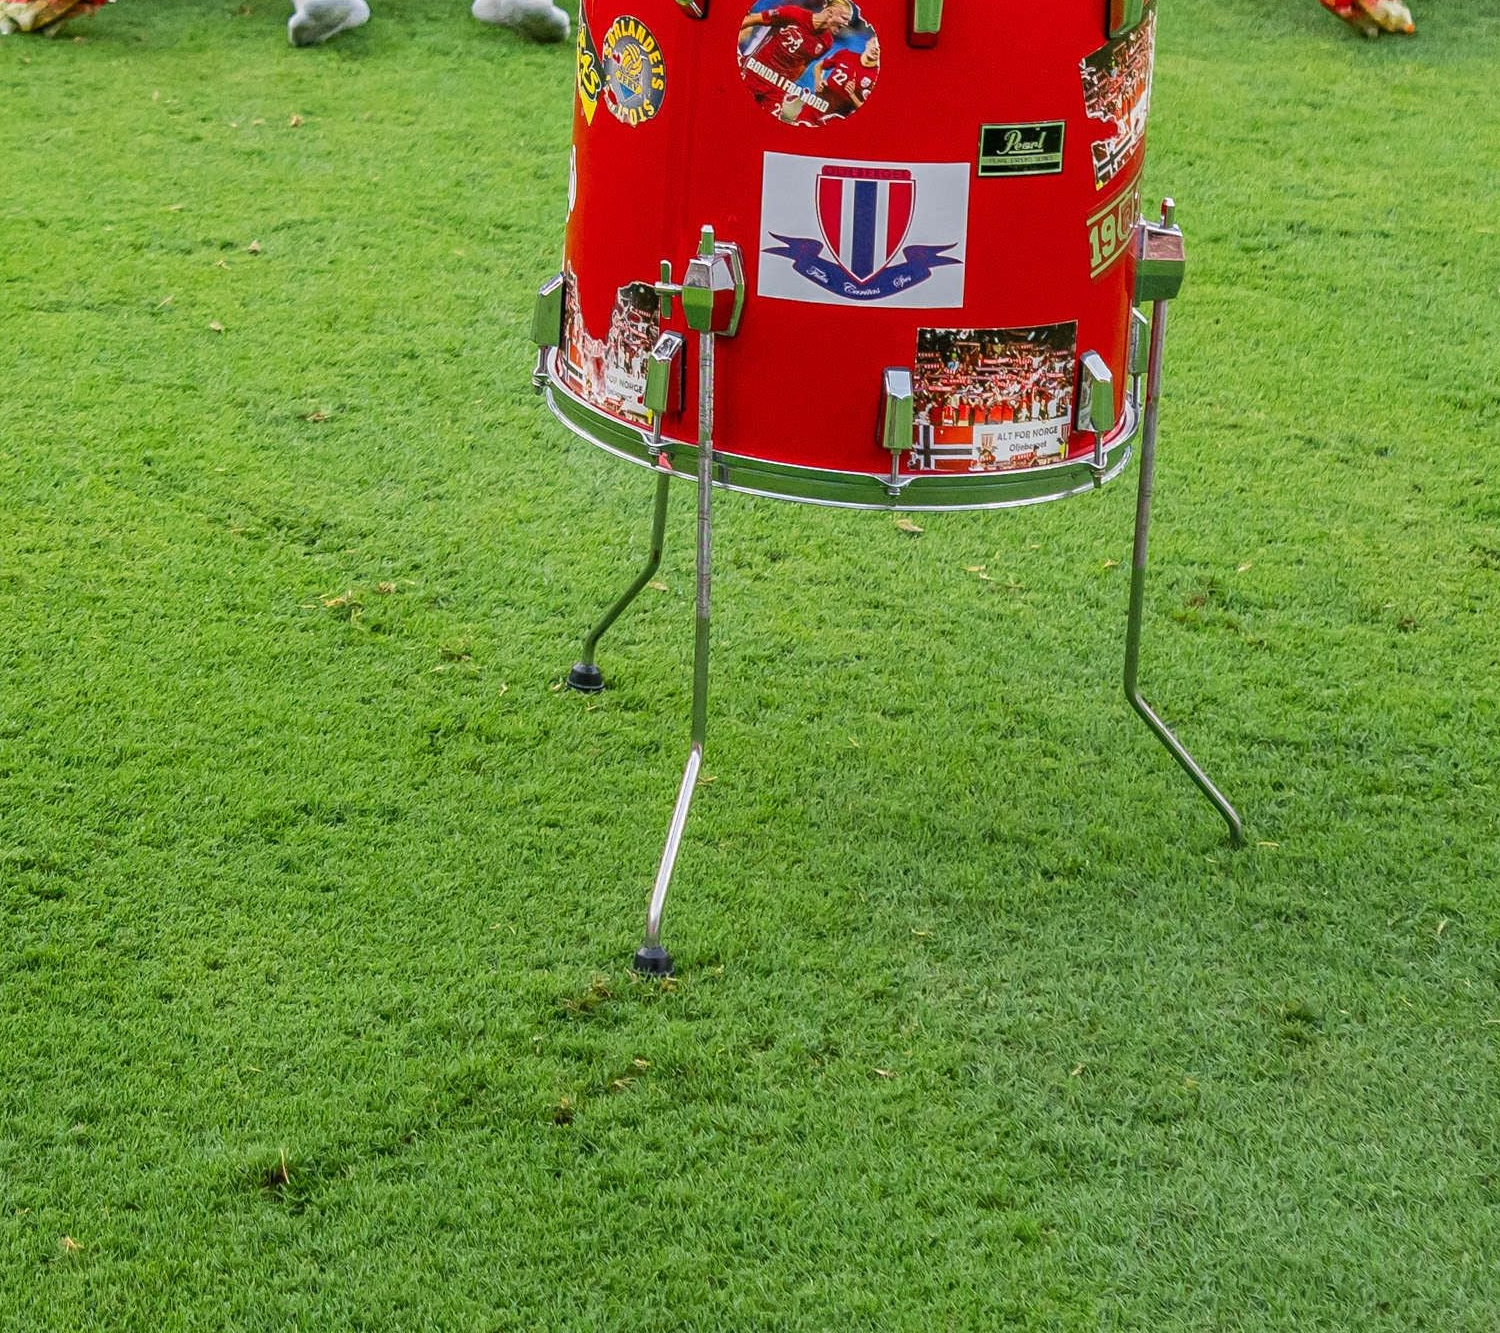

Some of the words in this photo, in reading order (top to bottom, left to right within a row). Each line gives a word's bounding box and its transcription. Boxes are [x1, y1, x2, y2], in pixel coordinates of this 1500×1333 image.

[781, 35, 802, 54] 23
[831, 68, 849, 86] 22
[996, 129, 1047, 155] Pearl
[996, 429, 1013, 441] ALT
[1014, 428, 1032, 440] FOR
[1032, 425, 1059, 437] NORGE
